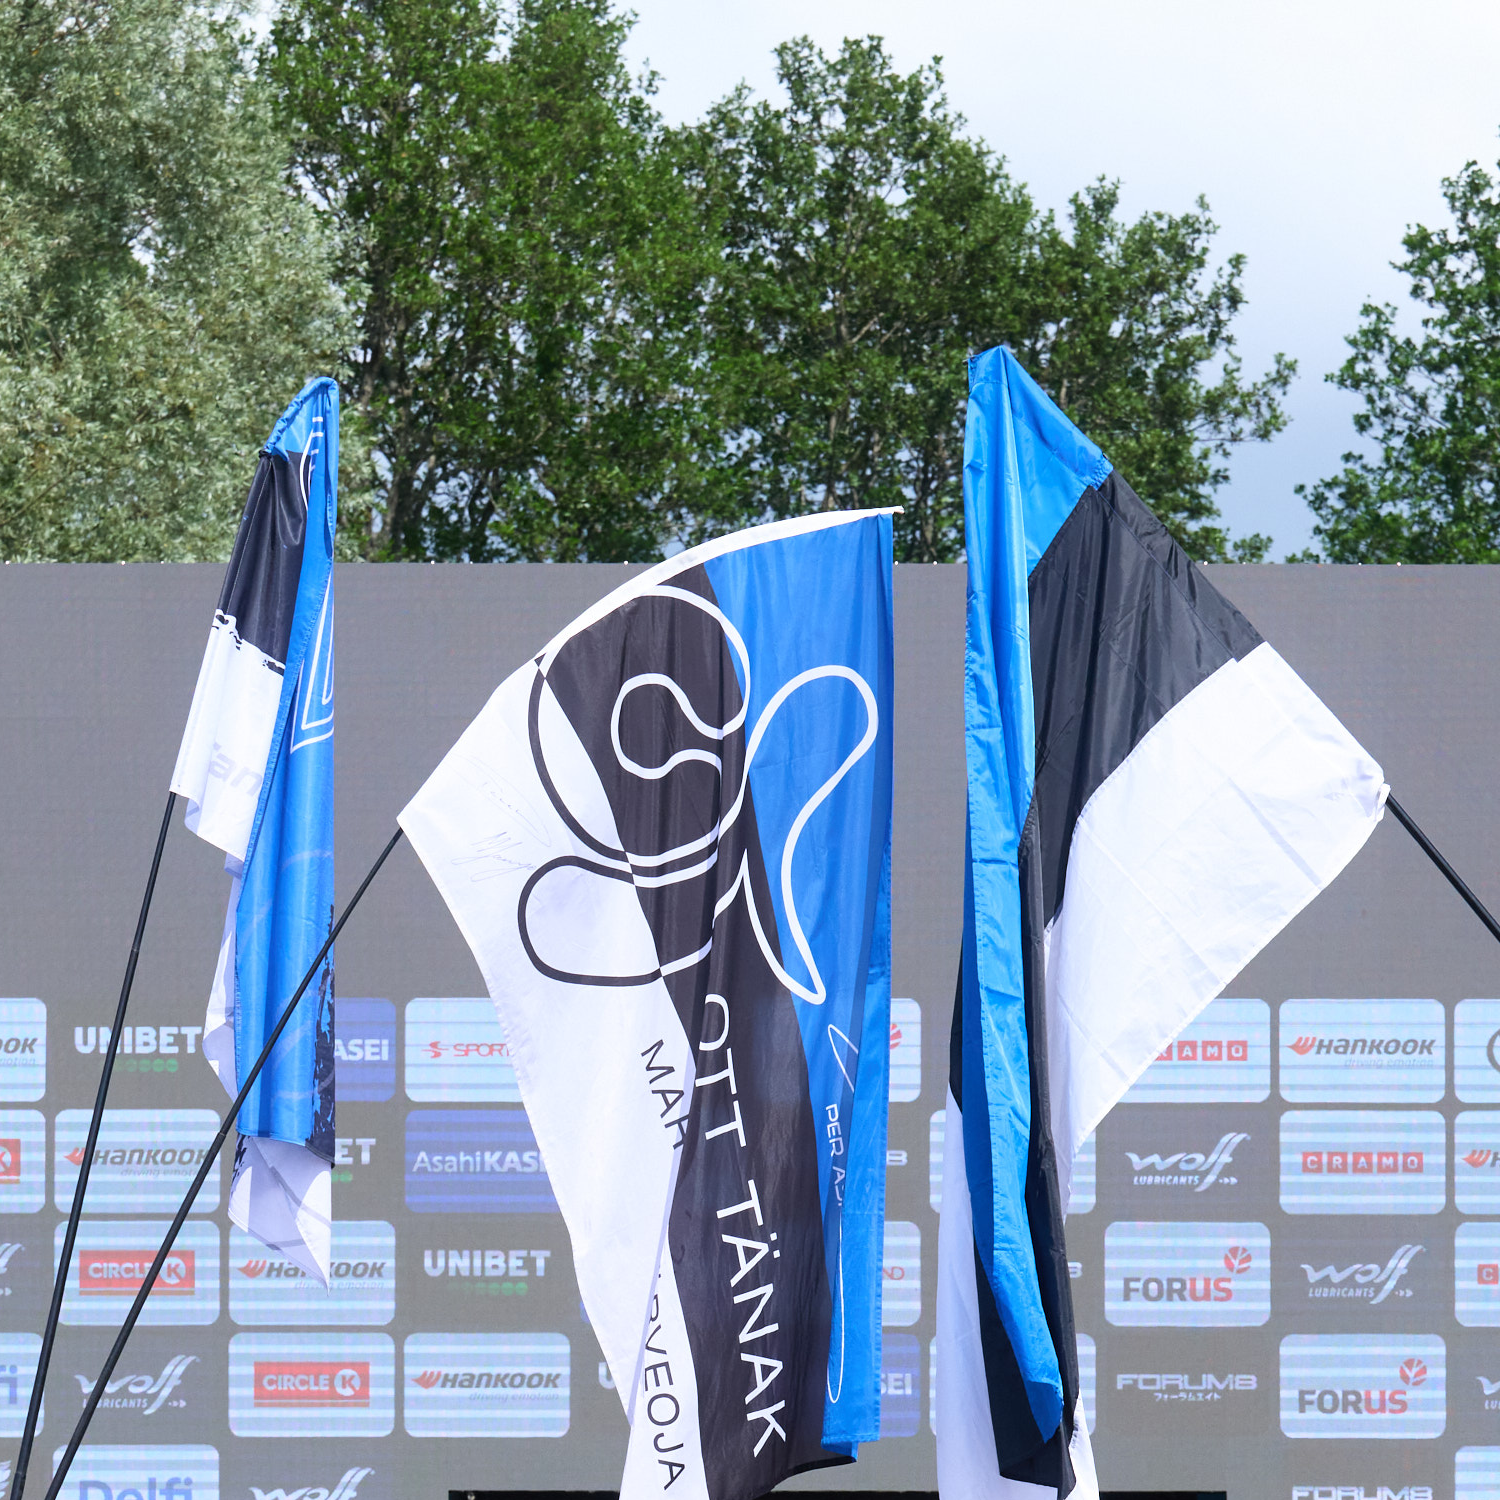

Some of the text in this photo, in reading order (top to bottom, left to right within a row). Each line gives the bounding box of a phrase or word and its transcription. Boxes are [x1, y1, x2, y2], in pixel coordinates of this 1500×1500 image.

[825, 1103, 845, 1158] PER
[1304, 1154, 1422, 1171] CRAMO
[1134, 1177, 1201, 1187] LUBRICANTS
[694, 993, 787, 1458] OTT TÄNAK
[423, 1248, 551, 1276] UNIBET
[1122, 1275, 1233, 1301] FORUS
[1309, 1288, 1376, 1298] LUBRICANTS
[264, 1375, 331, 1392] CIRCLE
[1116, 1372, 1259, 1390] FORUM8
[1297, 1387, 1408, 1413] FORUS
